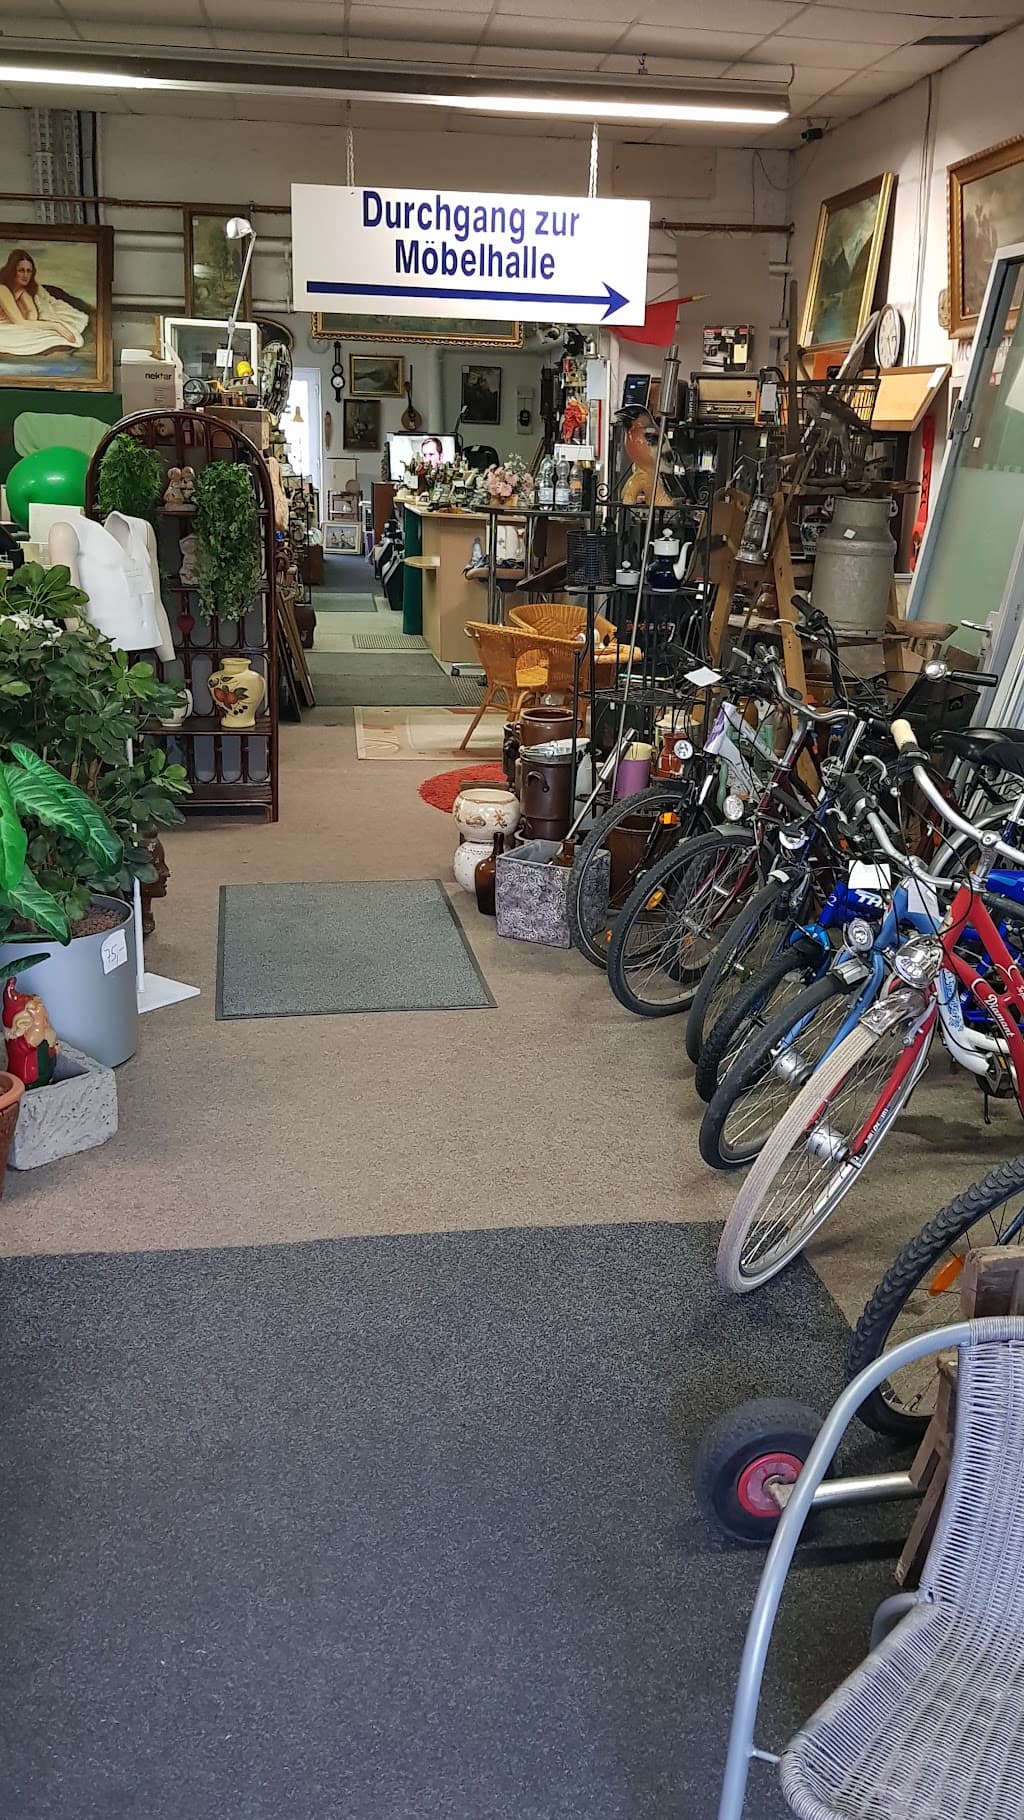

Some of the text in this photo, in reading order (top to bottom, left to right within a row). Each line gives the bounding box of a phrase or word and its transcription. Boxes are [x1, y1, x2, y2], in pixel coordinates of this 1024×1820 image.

[362, 190, 580, 244] Durchgang zur
[395, 239, 555, 280] Möbelhalle
[984, 994, 1016, 1039] Diamant
